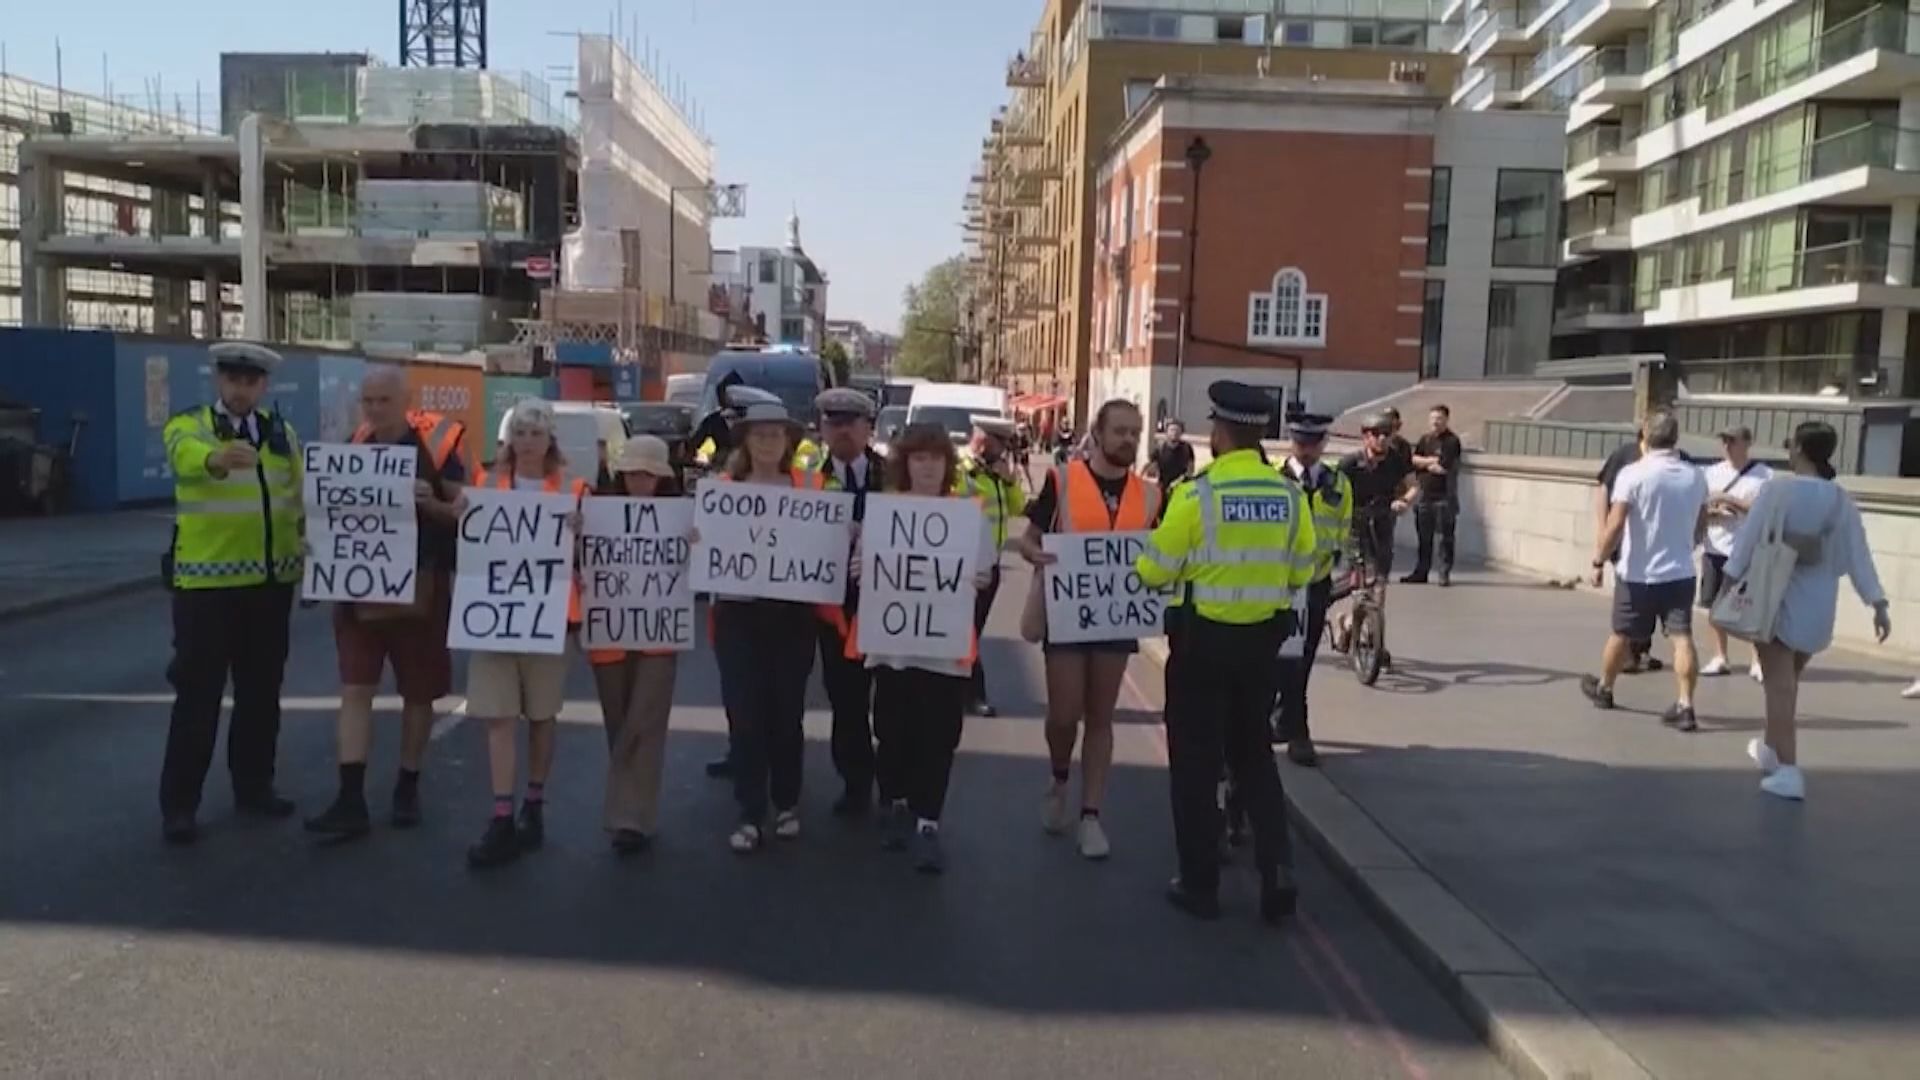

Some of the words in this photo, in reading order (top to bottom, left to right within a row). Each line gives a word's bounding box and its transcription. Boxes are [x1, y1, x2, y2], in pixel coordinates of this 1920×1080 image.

[306, 446, 364, 474] END
[371, 447, 412, 477] THE
[316, 477, 403, 507] FOSSIL
[702, 488, 766, 517] GOOD
[778, 495, 845, 524] PEOPLE
[327, 507, 398, 534] FOOL
[1224, 503, 1288, 520] POLICE
[890, 510, 949, 549] NO
[334, 534, 392, 562] ERA
[582, 535, 690, 567] FRIGHTENED
[1084, 538, 1145, 566] END
[312, 562, 413, 598] NOW
[488, 558, 565, 595] EAT
[709, 547, 757, 581] BAD
[769, 555, 837, 583] LAWS
[874, 552, 964, 593] NEW
[594, 570, 631, 598] FOR
[642, 572, 680, 597] MY
[1053, 572, 1115, 601] NEW
[463, 601, 554, 639] OIL
[588, 607, 689, 643] FUTURE
[883, 602, 947, 638] OIL
[1079, 604, 1098, 630] &
[1108, 599, 1159, 627] GAS
